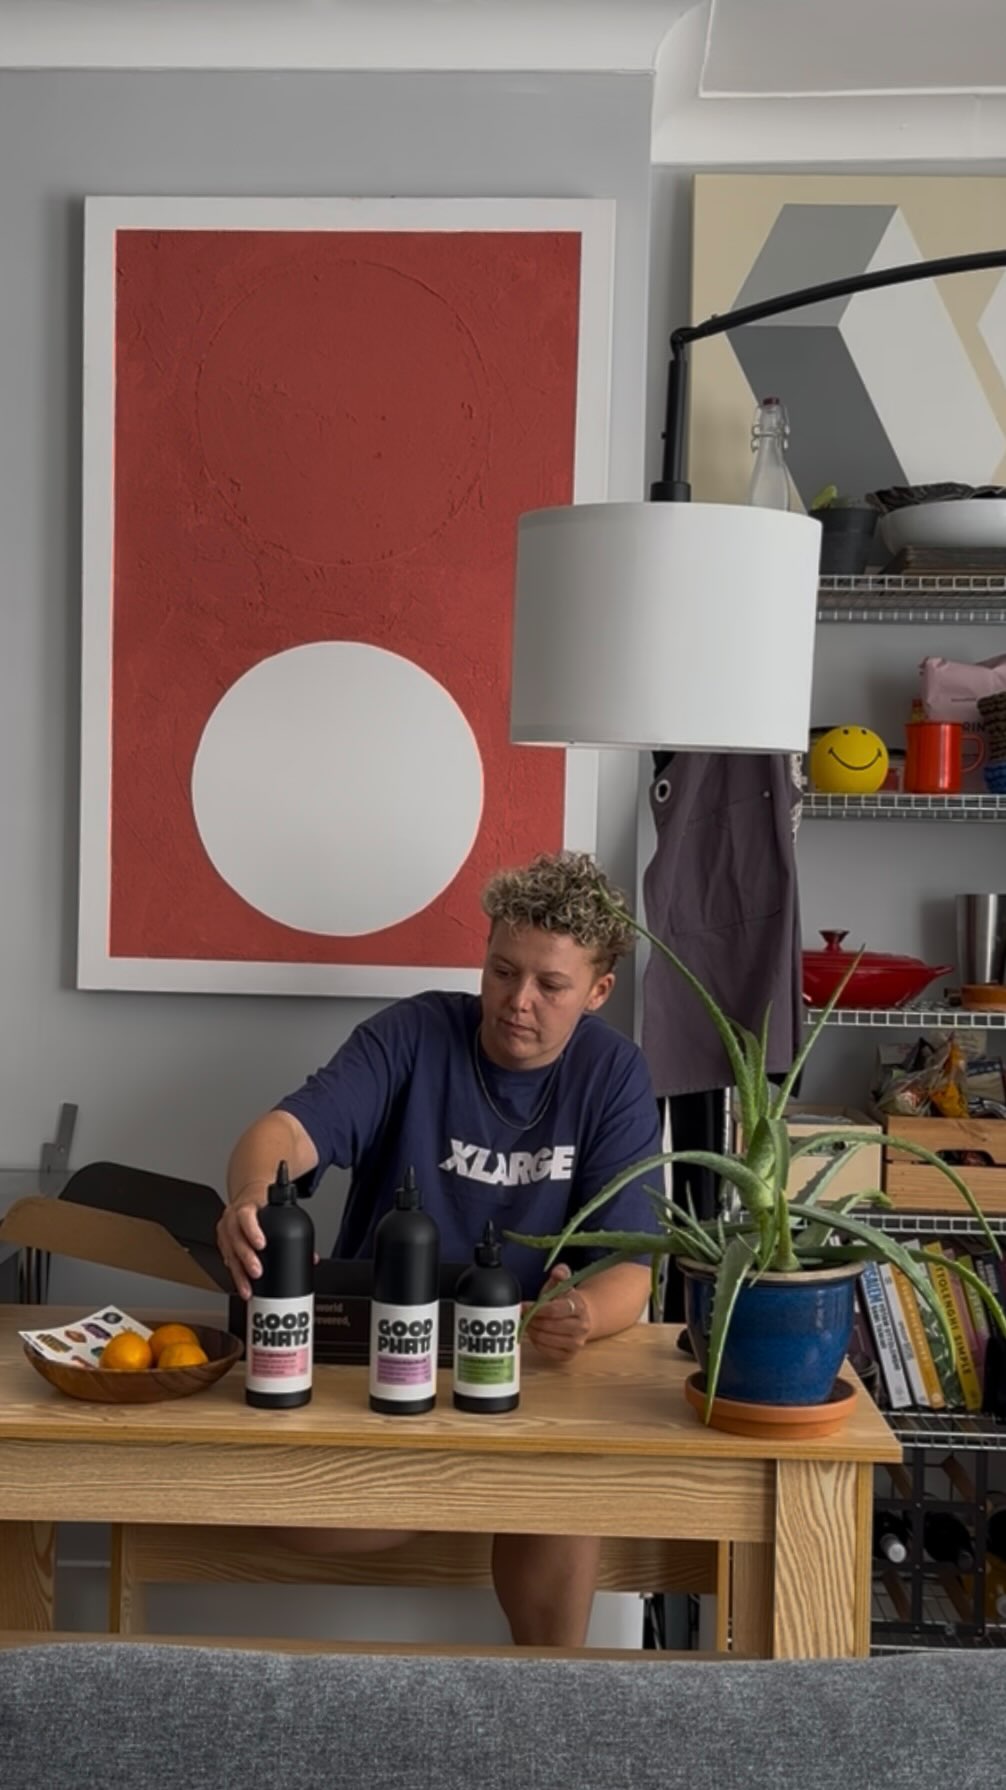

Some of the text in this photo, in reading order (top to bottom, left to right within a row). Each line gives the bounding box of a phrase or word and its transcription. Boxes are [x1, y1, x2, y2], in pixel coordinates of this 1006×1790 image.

[438, 1138, 575, 1185] XLARGE
[252, 1311, 310, 1330] GOOD
[378, 1318, 433, 1337] GOOD
[458, 1317, 515, 1336] GOOD
[935, 1265, 972, 1375] TTOLENGHI SIMPLE
[252, 1328, 310, 1347] PHATS
[458, 1334, 515, 1354] PHATS
